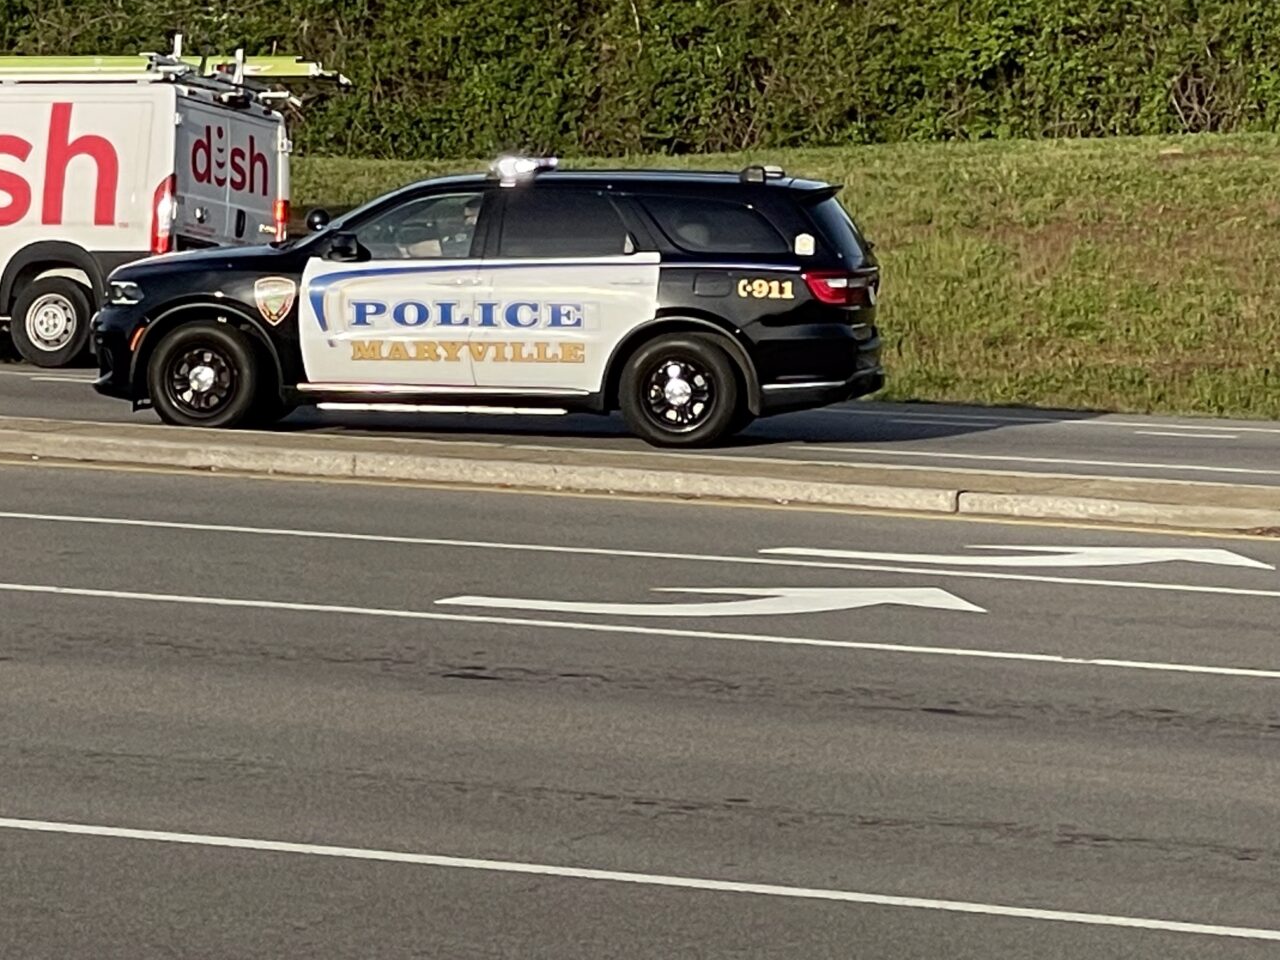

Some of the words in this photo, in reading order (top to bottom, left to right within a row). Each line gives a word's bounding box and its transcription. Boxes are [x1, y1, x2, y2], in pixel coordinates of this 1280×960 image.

[191, 125, 269, 197] dish
[350, 301, 583, 328] POLICE
[350, 341, 586, 364] MARYVILLE
